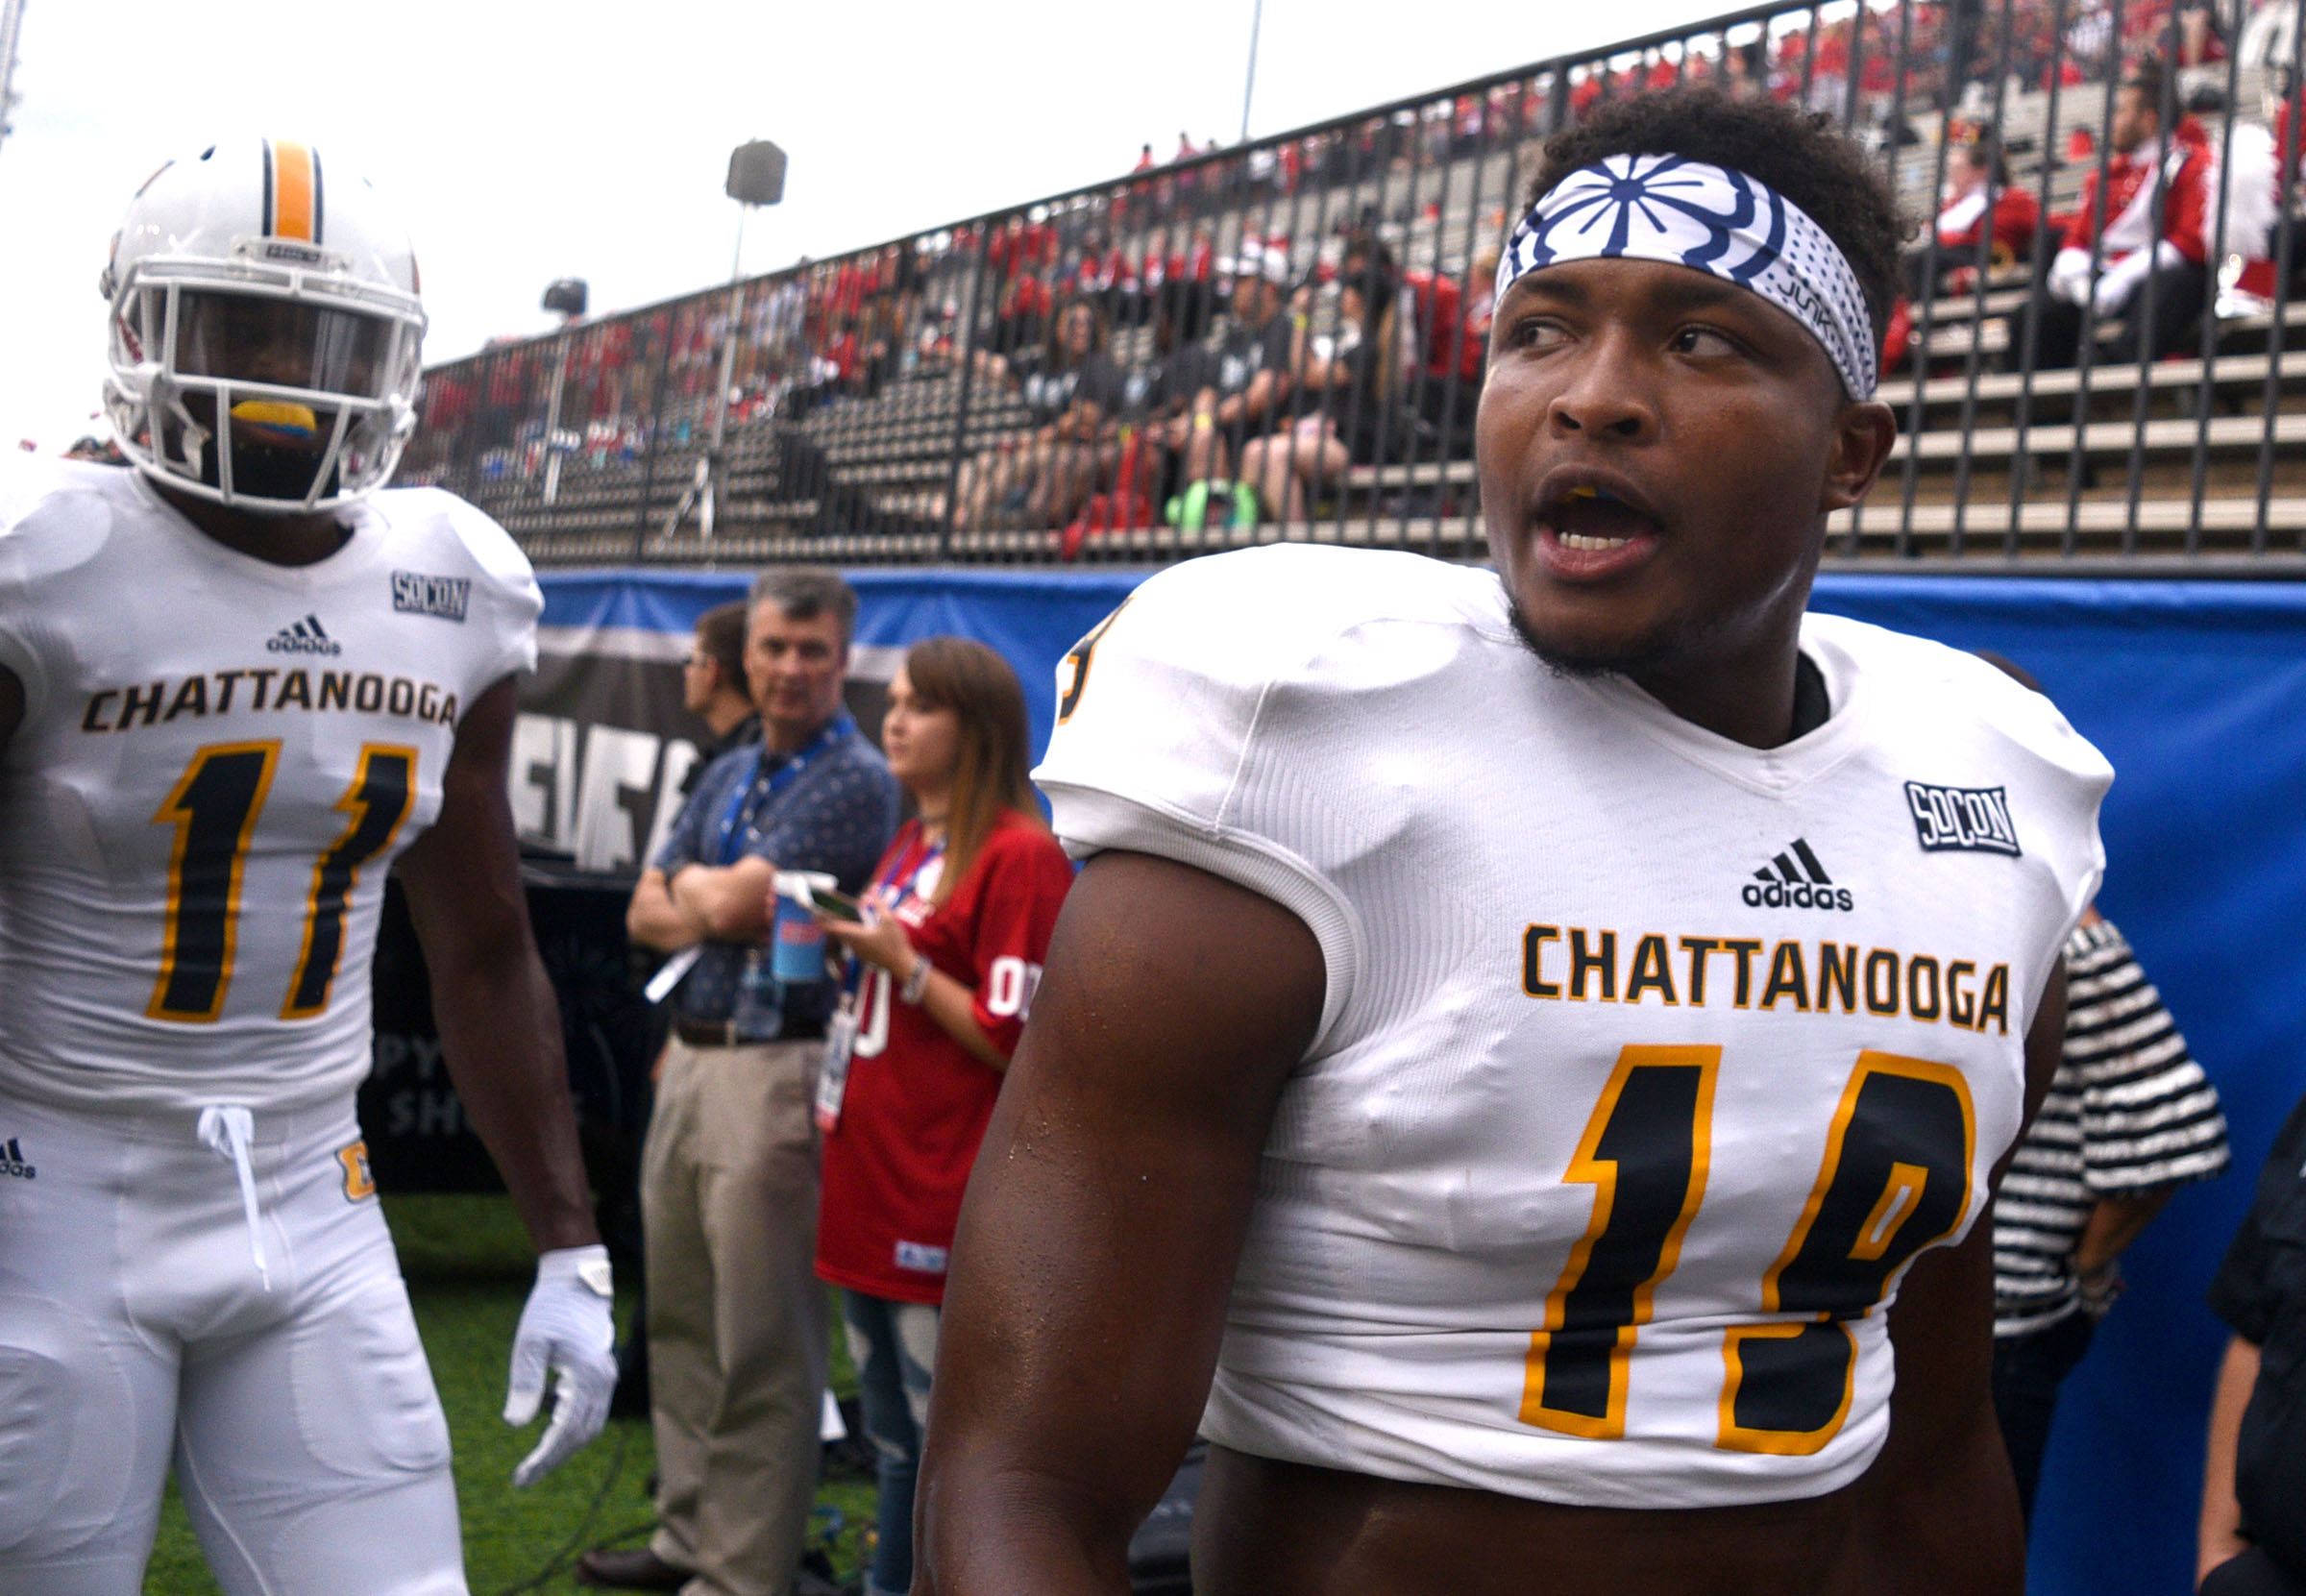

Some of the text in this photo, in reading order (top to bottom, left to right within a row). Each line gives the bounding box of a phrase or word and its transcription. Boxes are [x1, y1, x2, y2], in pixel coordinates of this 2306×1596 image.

[393, 573, 468, 619] SOCON
[266, 635, 341, 657] adidas
[81, 669, 458, 733] CHATTANOOGA
[1906, 782, 2018, 850] SOCON
[144, 739, 419, 1023] 11
[1742, 880, 1853, 912] adidas
[1522, 923, 2010, 1036] CHATTANOOGA
